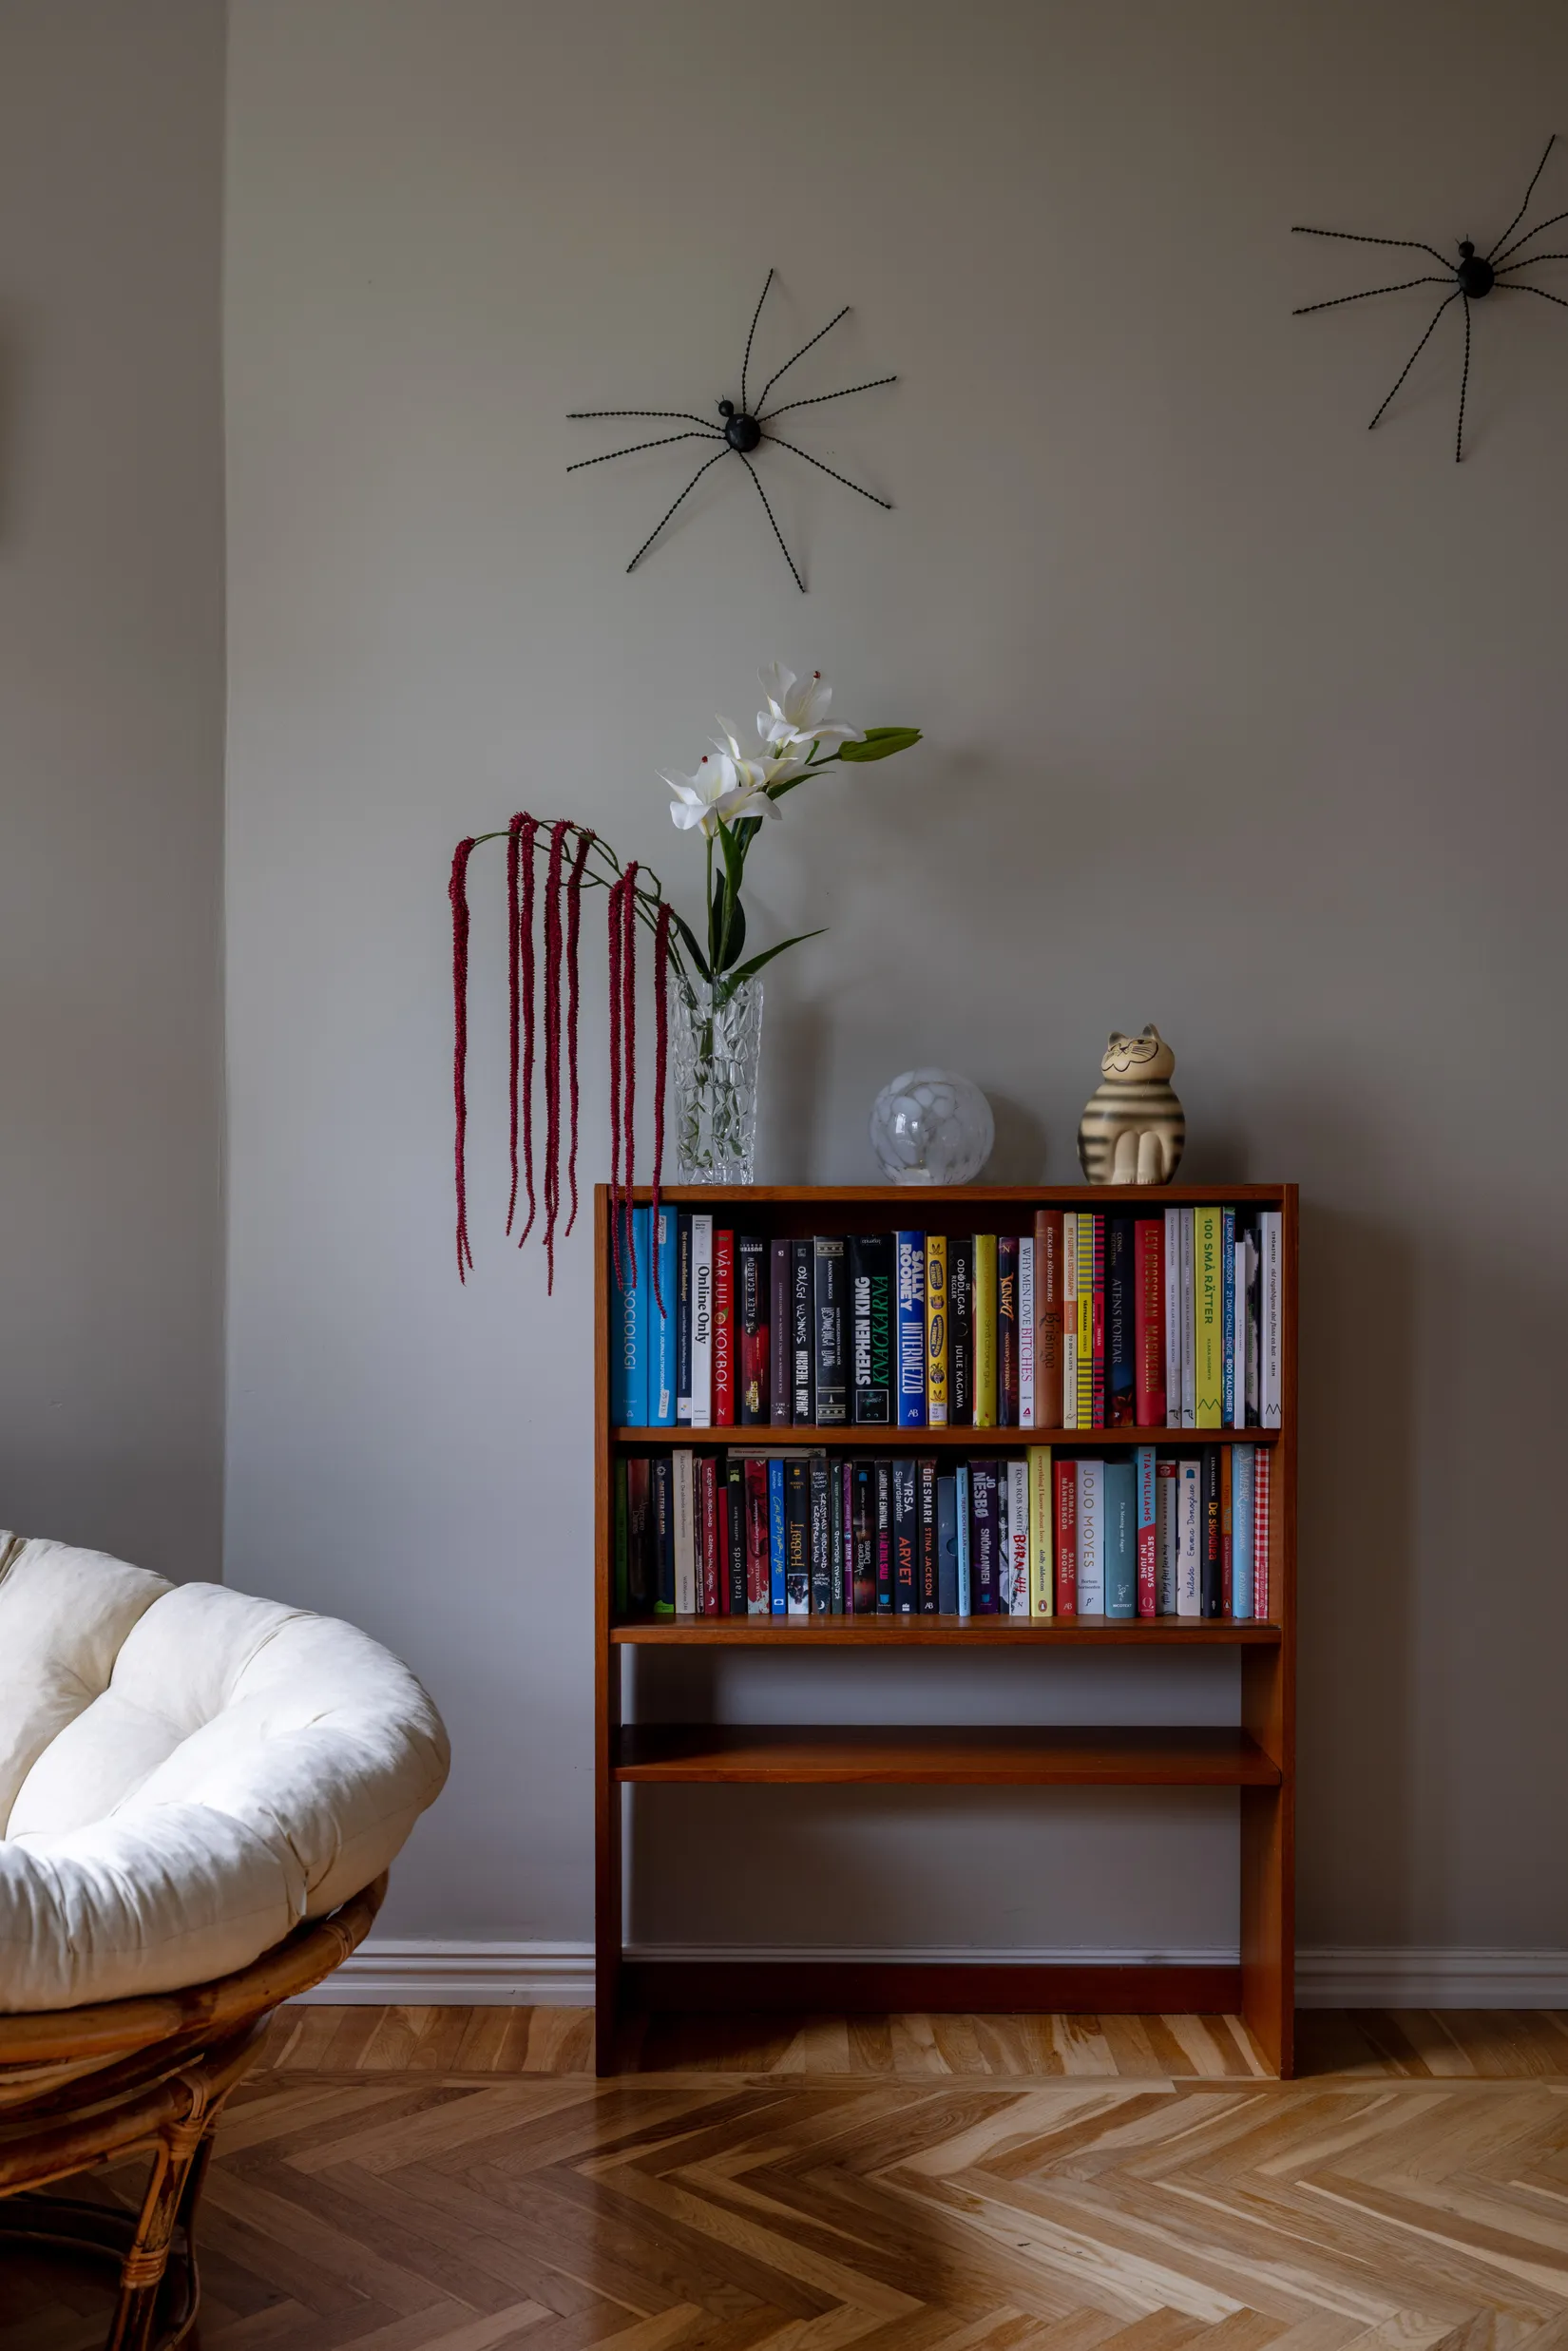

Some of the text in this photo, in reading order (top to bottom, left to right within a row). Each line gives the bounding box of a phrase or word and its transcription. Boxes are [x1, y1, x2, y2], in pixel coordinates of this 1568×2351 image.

[900, 1244, 911, 1311] ROONEY
[912, 1251, 924, 1302] SALLY
[1000, 1271, 1014, 1321] DANDY
[1204, 1218, 1215, 1324] 100 SMÅ RÄTTER
[623, 1290, 636, 1369] SOCIOLOGI
[695, 1267, 709, 1344] Online Only
[715, 1249, 730, 1392] VÅR JUL KOKBOK
[872, 1275, 889, 1386] KNACKARNA
[1022, 1248, 1032, 1382] WHY MEN LOVE BITCHES
[1112, 1279, 1121, 1364] ATENS PORTAR
[1145, 1230, 1158, 1393] LEV GROSSMAN MAGIKERNA
[796, 1267, 808, 1416] JOHAN THEORIN PSYKO
[855, 1277, 870, 1385] STEPHEN KING
[902, 1322, 923, 1394] INTERMEZZO
[955, 1346, 964, 1367] JULIE
[879, 1469, 888, 1500] CAROLINE
[894, 1471, 903, 1522] Sigurdardóttir
[904, 1481, 913, 1512] YRSA
[973, 1472, 988, 1518] NESBØ
[985, 1476, 996, 1488] JO
[1237, 1450, 1252, 1506] SVAMPAR
[879, 1501, 888, 1529] ENGVALL
[1083, 1470, 1094, 1568] JOJO MOYES
[1209, 1502, 1218, 1516] De
[733, 1547, 741, 1572] lords
[791, 1521, 805, 1566] HOBBIT
[854, 1544, 864, 1573] Vampire
[879, 1540, 889, 1549] ÅR
[899, 1537, 911, 1585] ARVET
[980, 1529, 991, 1584] SNÖMANNEN
[1013, 1535, 1026, 1571] BARN
[1141, 1544, 1147, 1554] IN
[880, 1564, 889, 1579] SALU
[1015, 1577, 1025, 1593] 44
